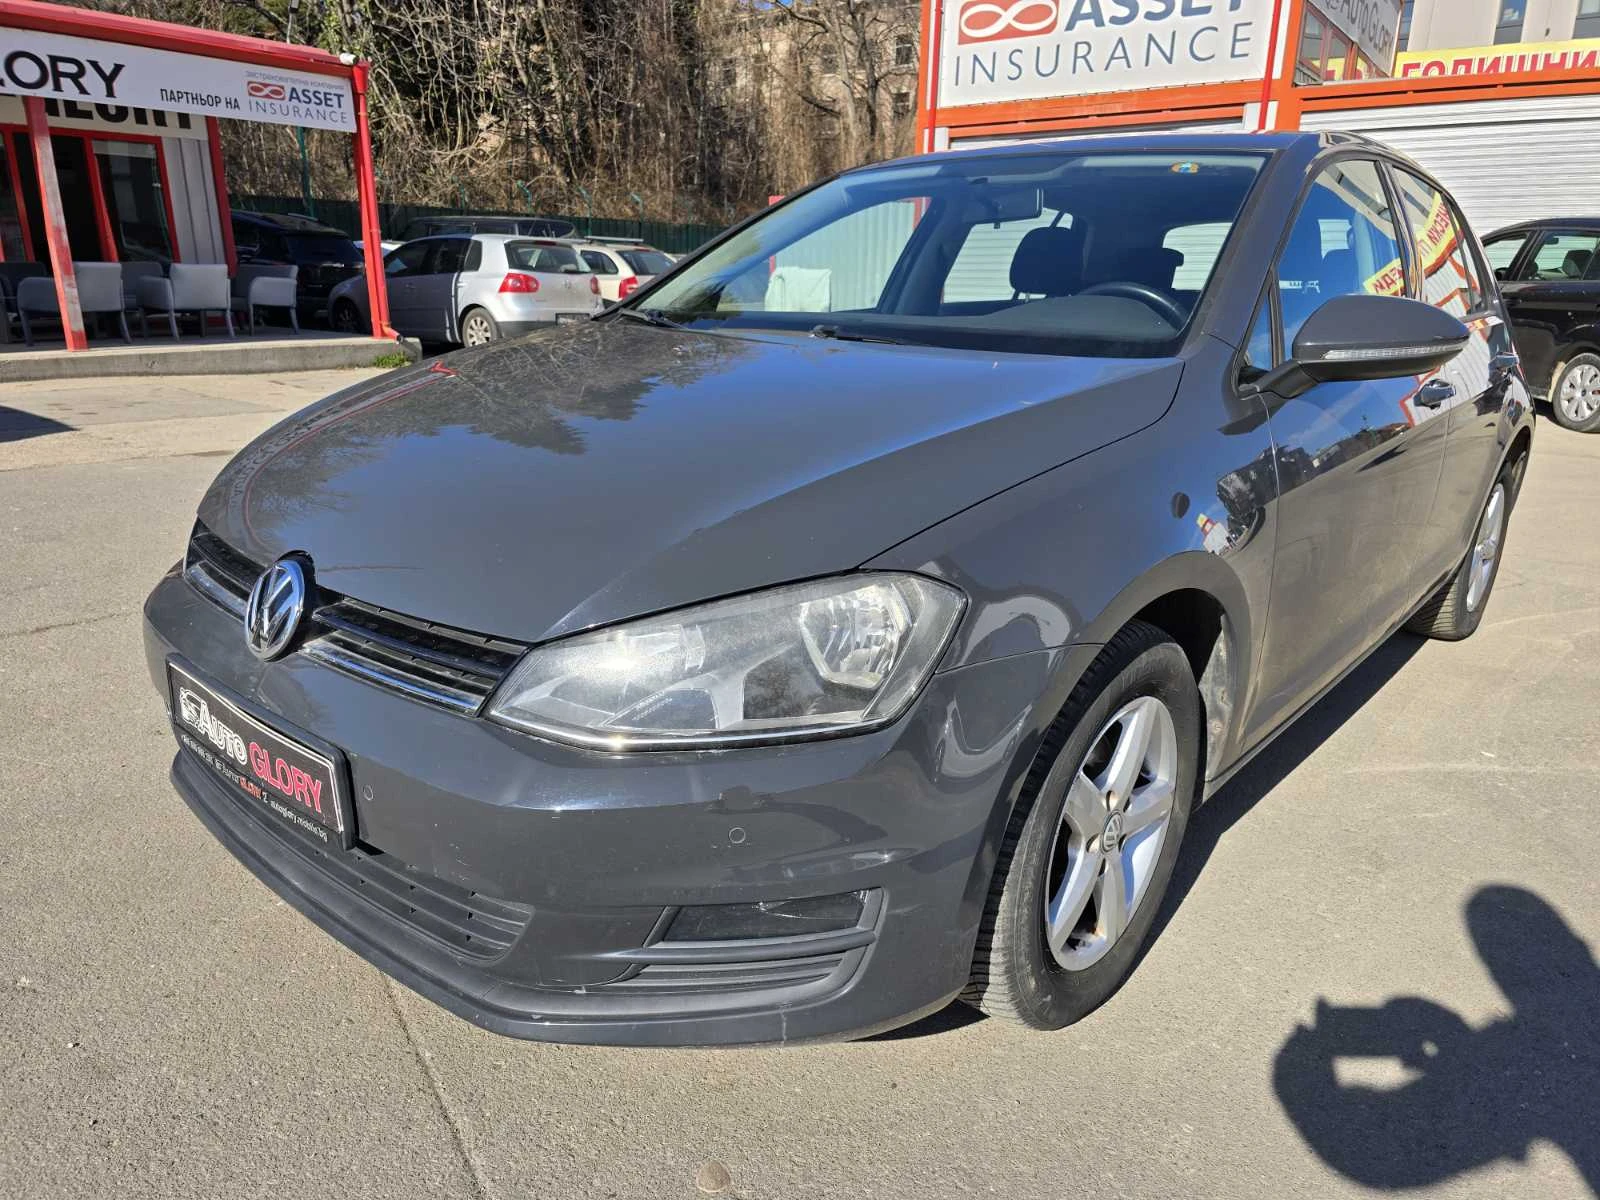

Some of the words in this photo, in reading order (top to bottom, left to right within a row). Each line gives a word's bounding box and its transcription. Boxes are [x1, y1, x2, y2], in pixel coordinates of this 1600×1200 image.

[954, 21, 1254, 86] INSURANCE
[0, 50, 126, 98] ORY
[160, 88, 222, 108] ПАРТНЬОР
[225, 97, 240, 110] НА
[248, 100, 348, 124] INSURANCE
[288, 87, 345, 109] ASSET
[249, 741, 322, 813] GLORY
